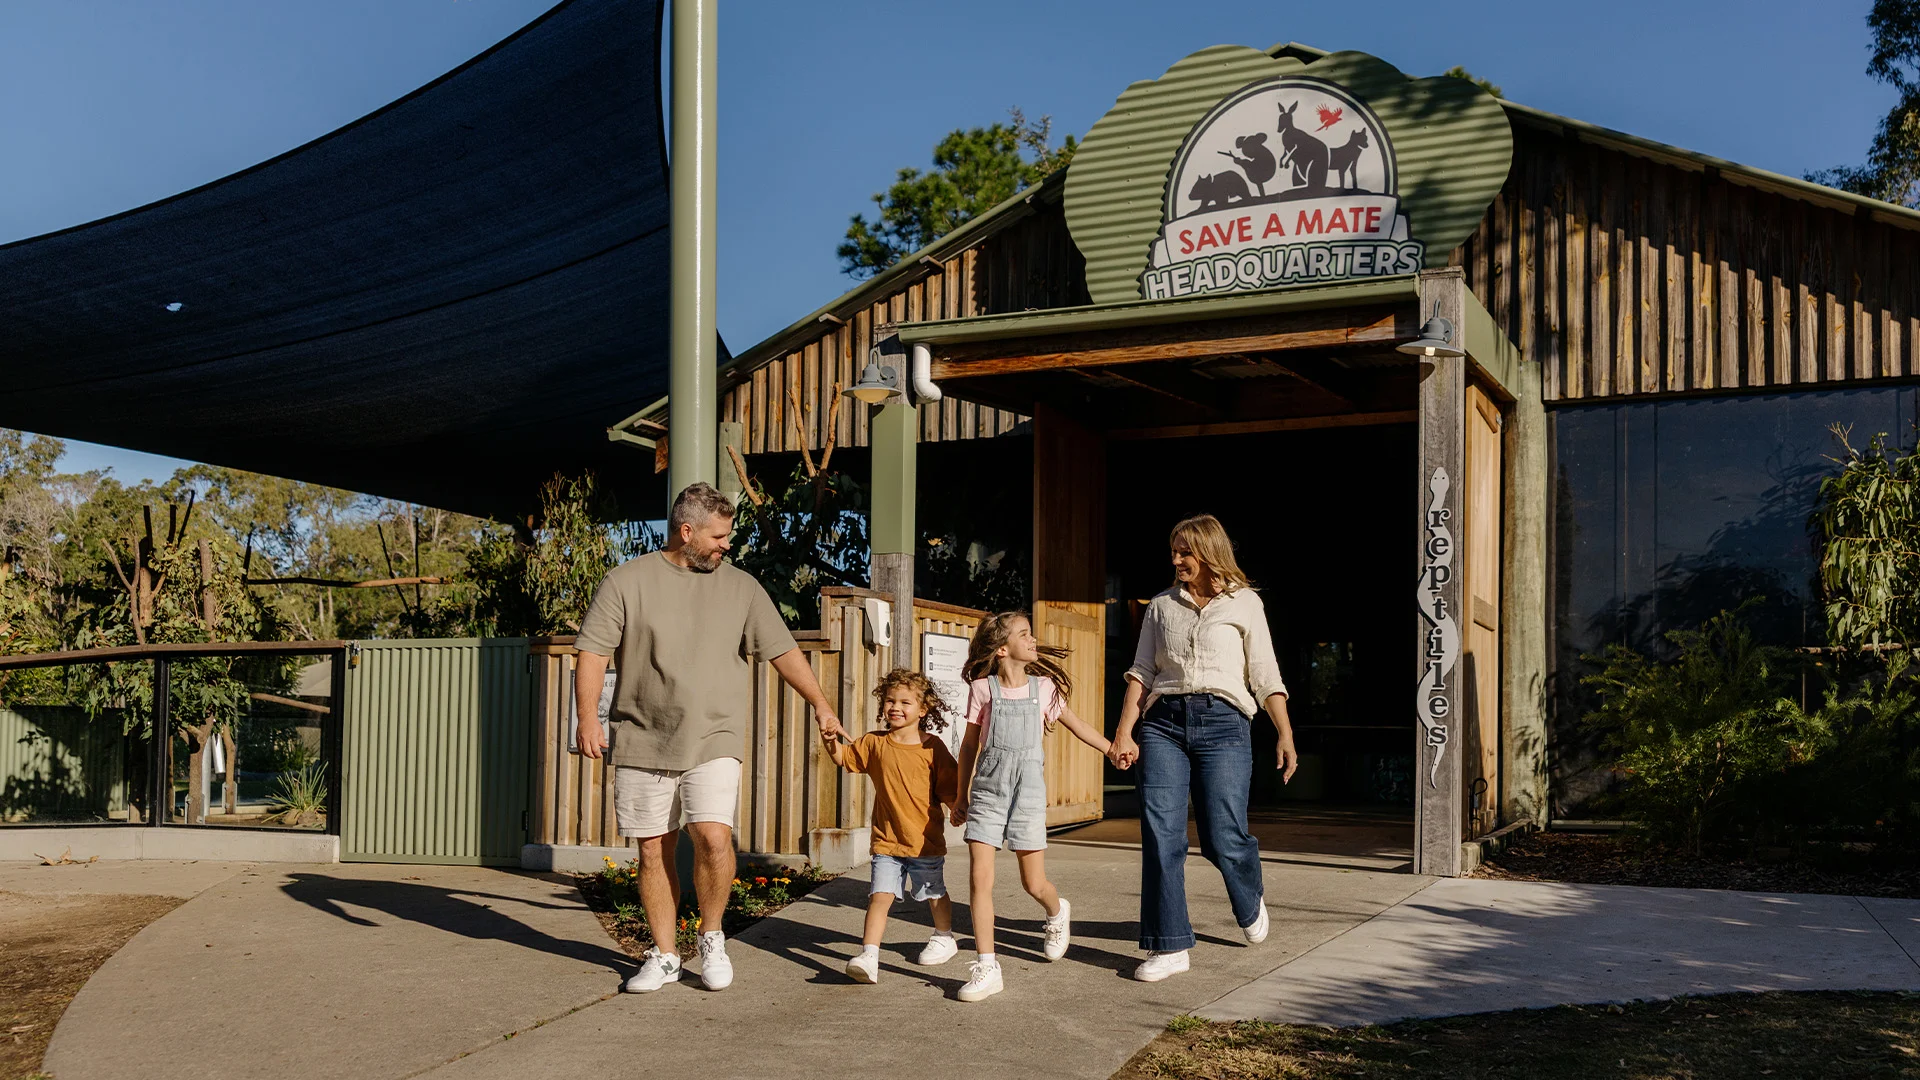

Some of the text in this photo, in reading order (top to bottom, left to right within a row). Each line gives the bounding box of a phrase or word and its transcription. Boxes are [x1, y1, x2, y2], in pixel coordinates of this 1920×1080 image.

[1179, 207, 1381, 254] SAVE A MATE
[1146, 245, 1419, 300] HEADQUARTERS
[1427, 509, 1449, 744] reptiles
[661, 961, 674, 975] N
